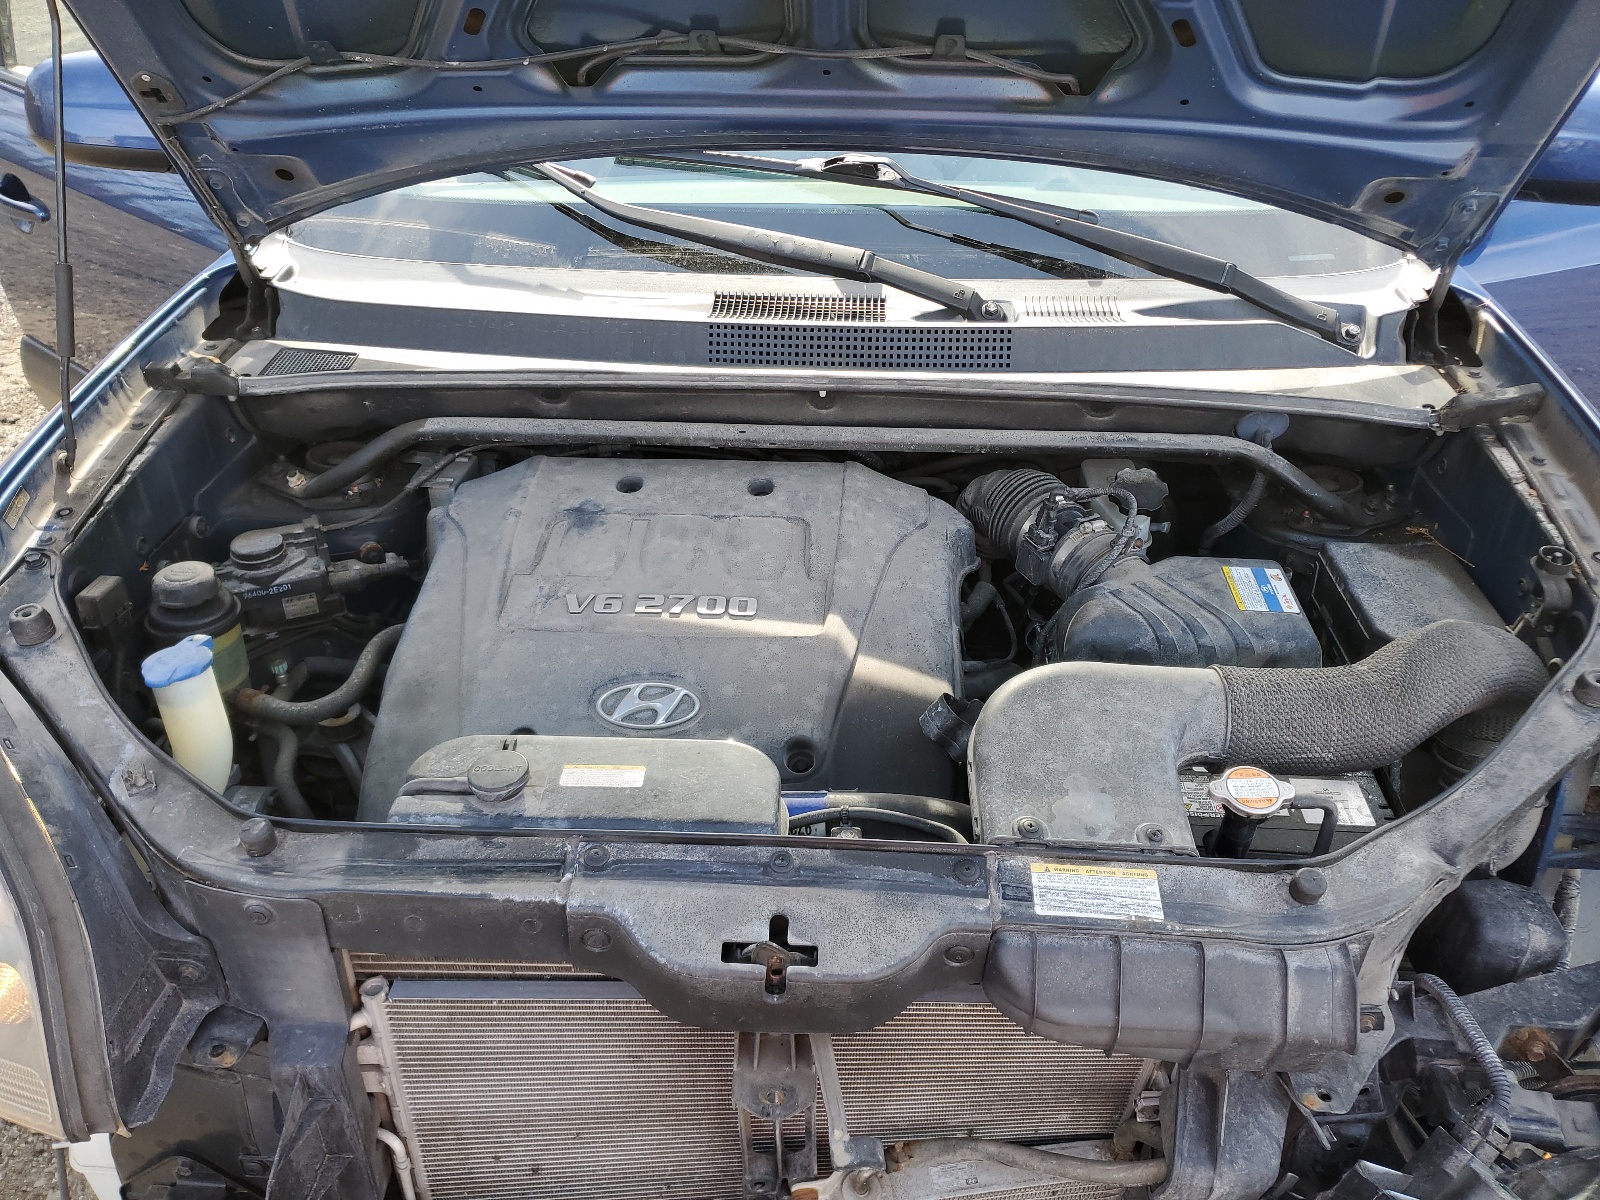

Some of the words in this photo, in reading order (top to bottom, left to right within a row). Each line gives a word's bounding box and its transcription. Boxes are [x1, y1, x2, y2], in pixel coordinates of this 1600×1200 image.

[565, 593, 623, 614] V6
[634, 593, 758, 618] 2700
[473, 764, 523, 773] COOLANT
